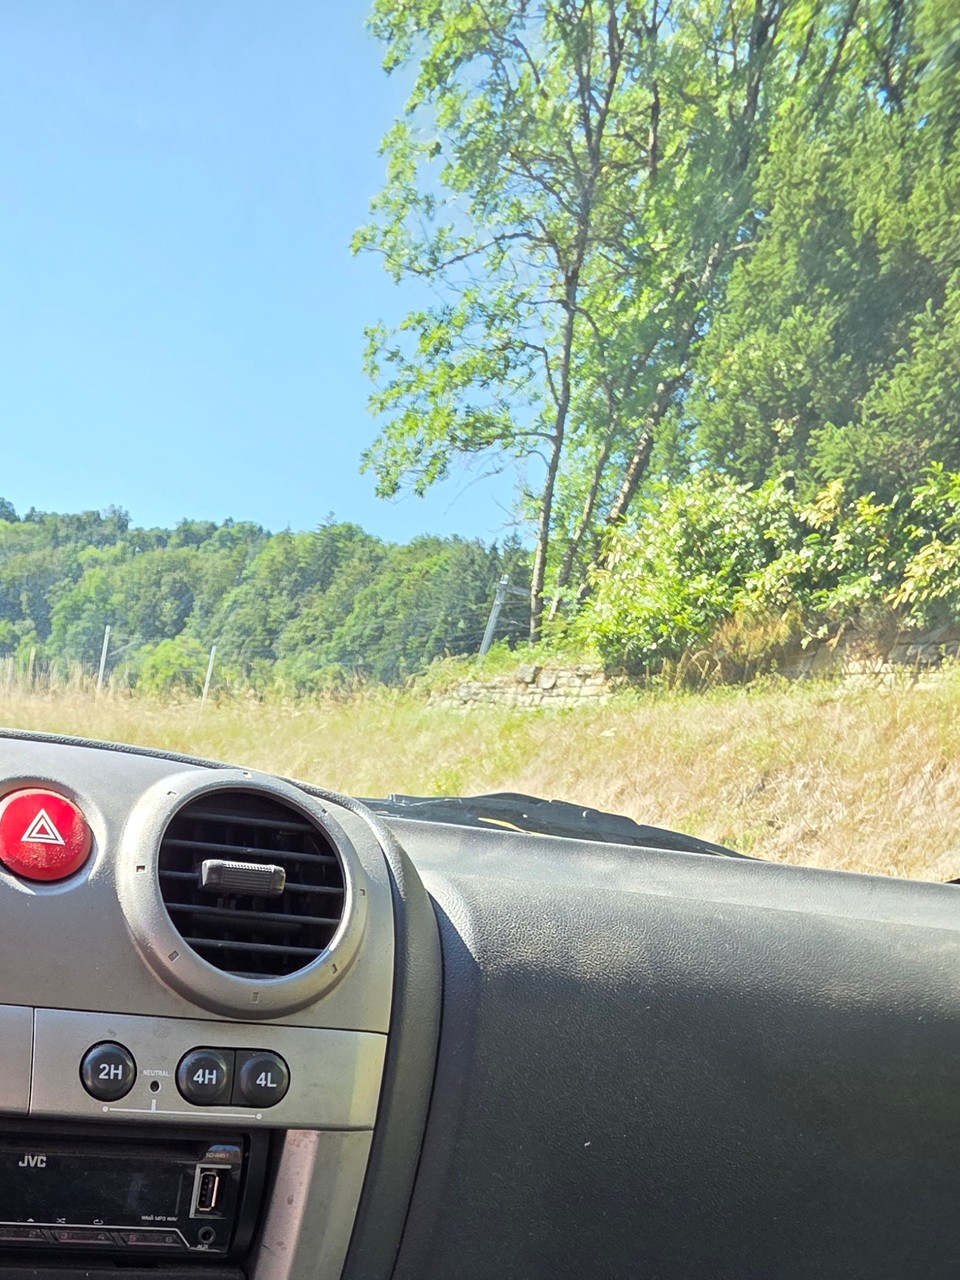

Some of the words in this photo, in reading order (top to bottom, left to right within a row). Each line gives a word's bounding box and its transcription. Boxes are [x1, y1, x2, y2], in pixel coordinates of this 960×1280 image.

[98, 1063, 123, 1080] 2H
[142, 1069, 170, 1078] NEUTRAL
[192, 1069, 217, 1085] 4H
[255, 1072, 277, 1088] 4L
[18, 1155, 47, 1168] JVC
